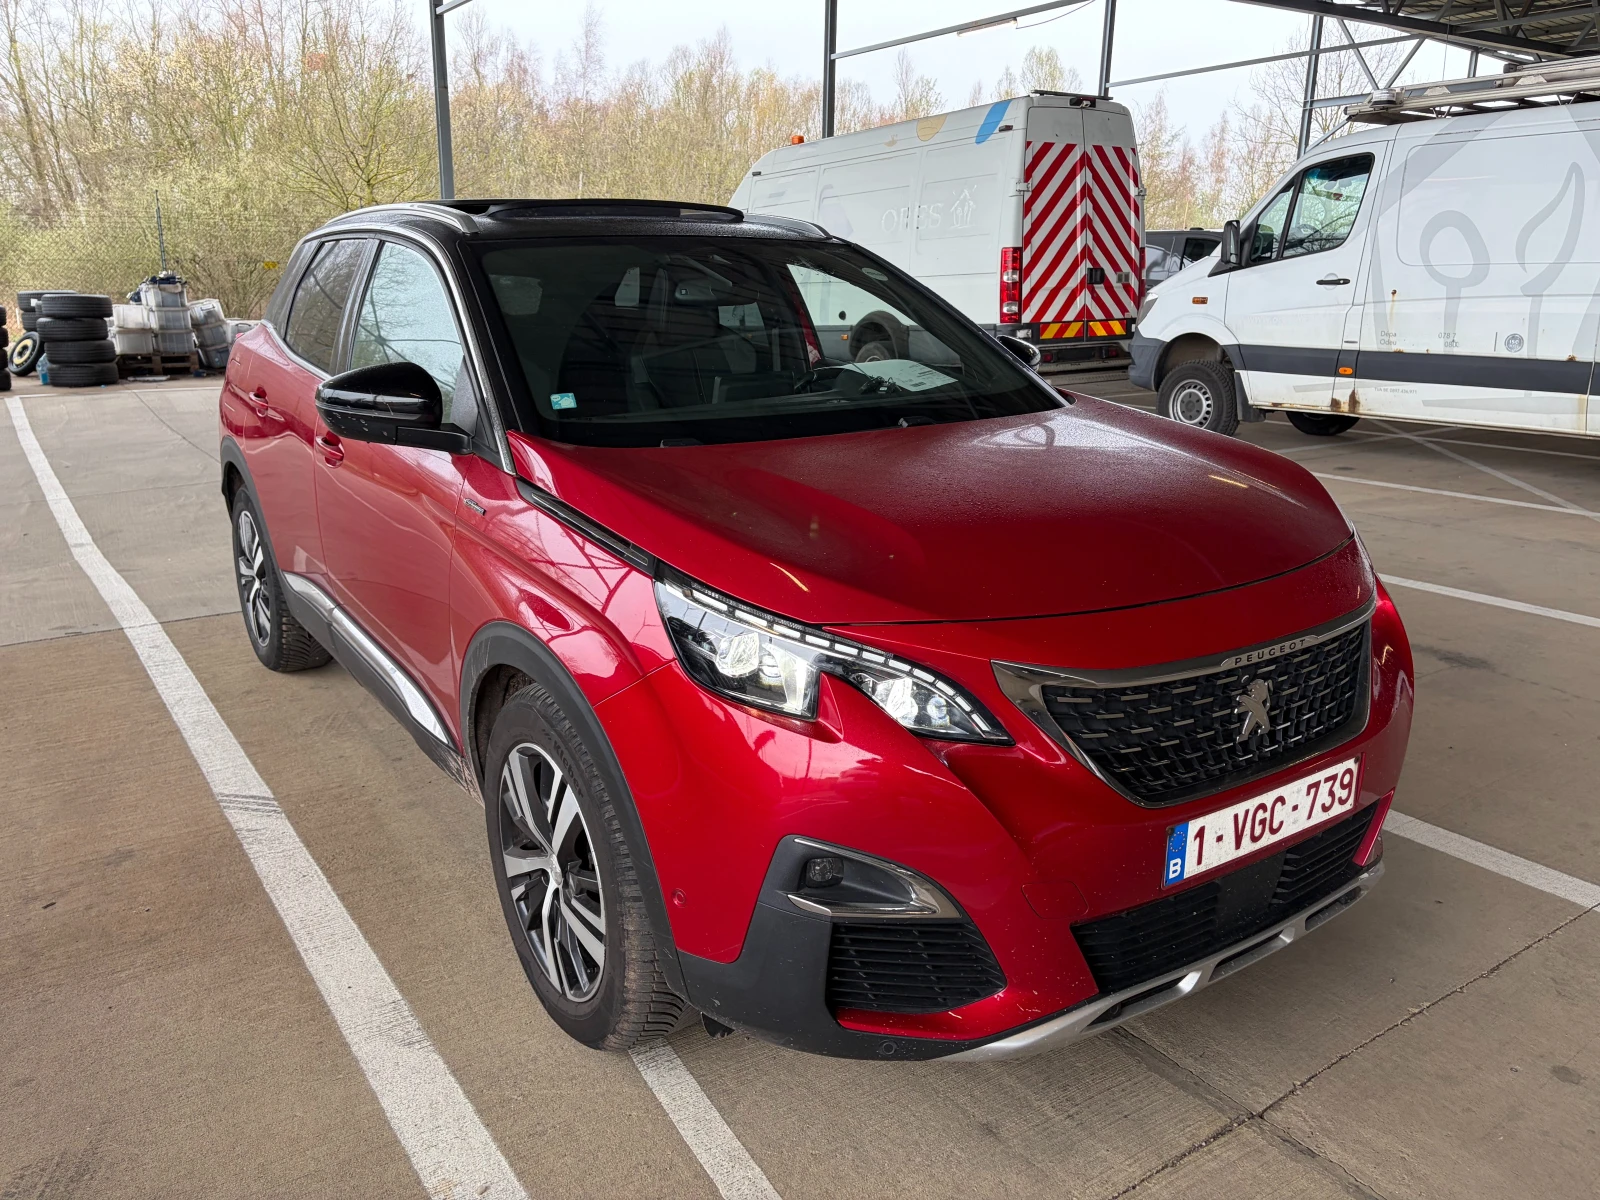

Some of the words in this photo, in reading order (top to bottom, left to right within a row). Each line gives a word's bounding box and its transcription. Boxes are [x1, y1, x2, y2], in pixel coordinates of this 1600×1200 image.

[881, 202, 944, 233] ORES
[1234, 638, 1306, 666] PEUGEOT
[553, 740, 584, 798] Kleber
[1168, 858, 1182, 879] B
